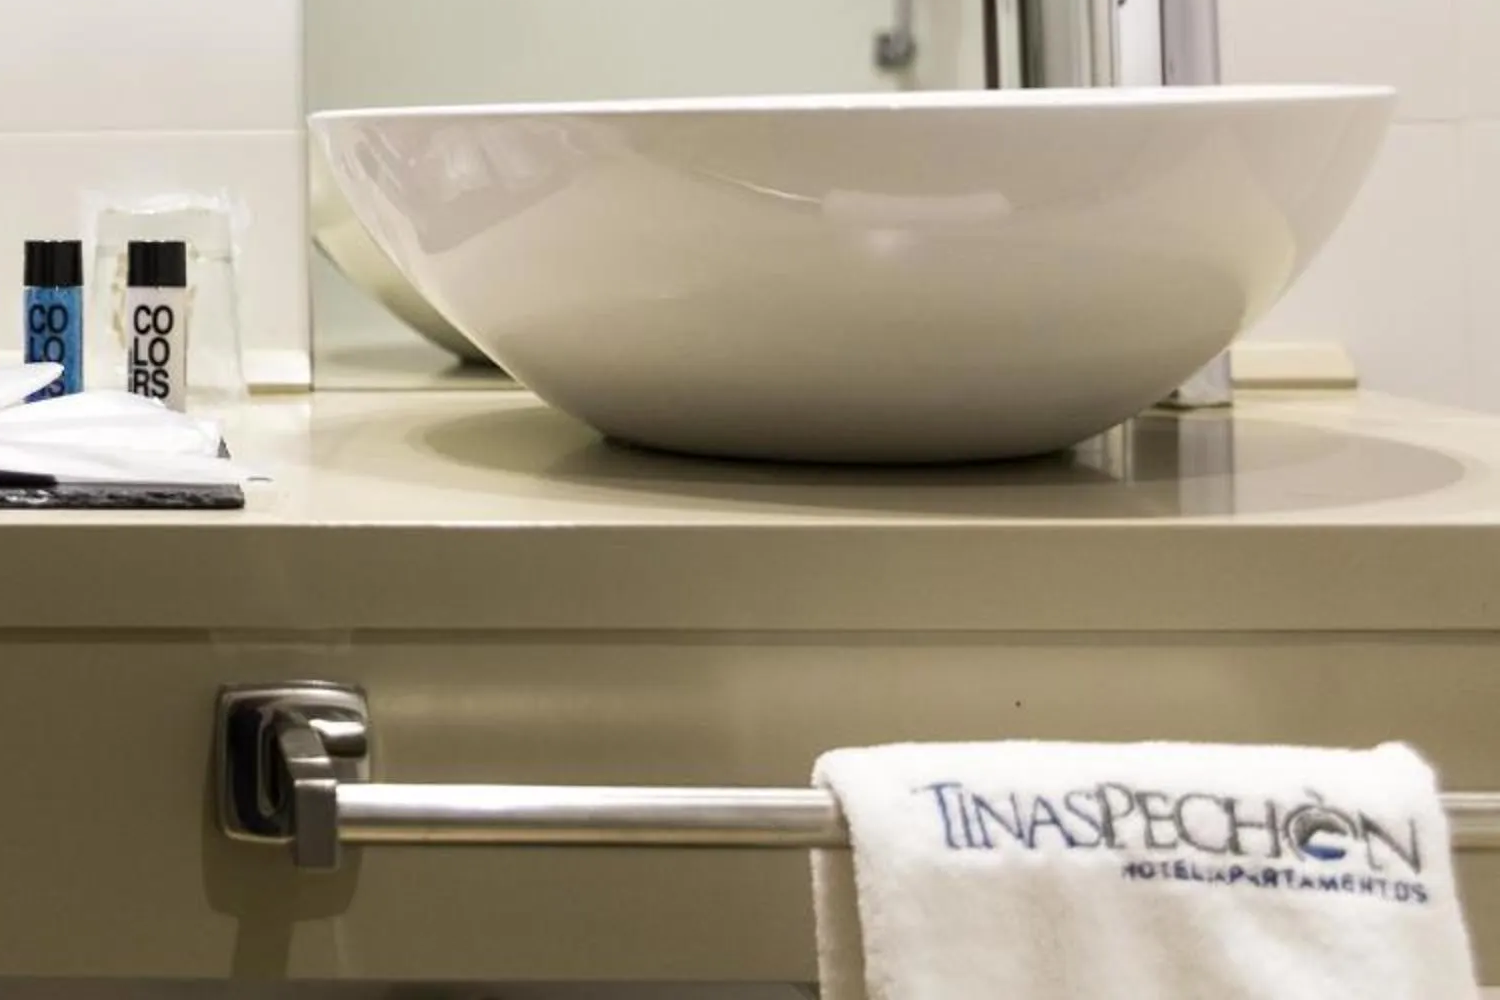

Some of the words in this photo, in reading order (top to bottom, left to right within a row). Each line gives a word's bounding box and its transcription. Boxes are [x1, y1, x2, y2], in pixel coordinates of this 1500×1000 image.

[29, 304, 68, 333] CO
[133, 304, 174, 335] CO
[29, 336, 65, 363] LO
[133, 337, 171, 366] LO
[133, 368, 170, 399] RS
